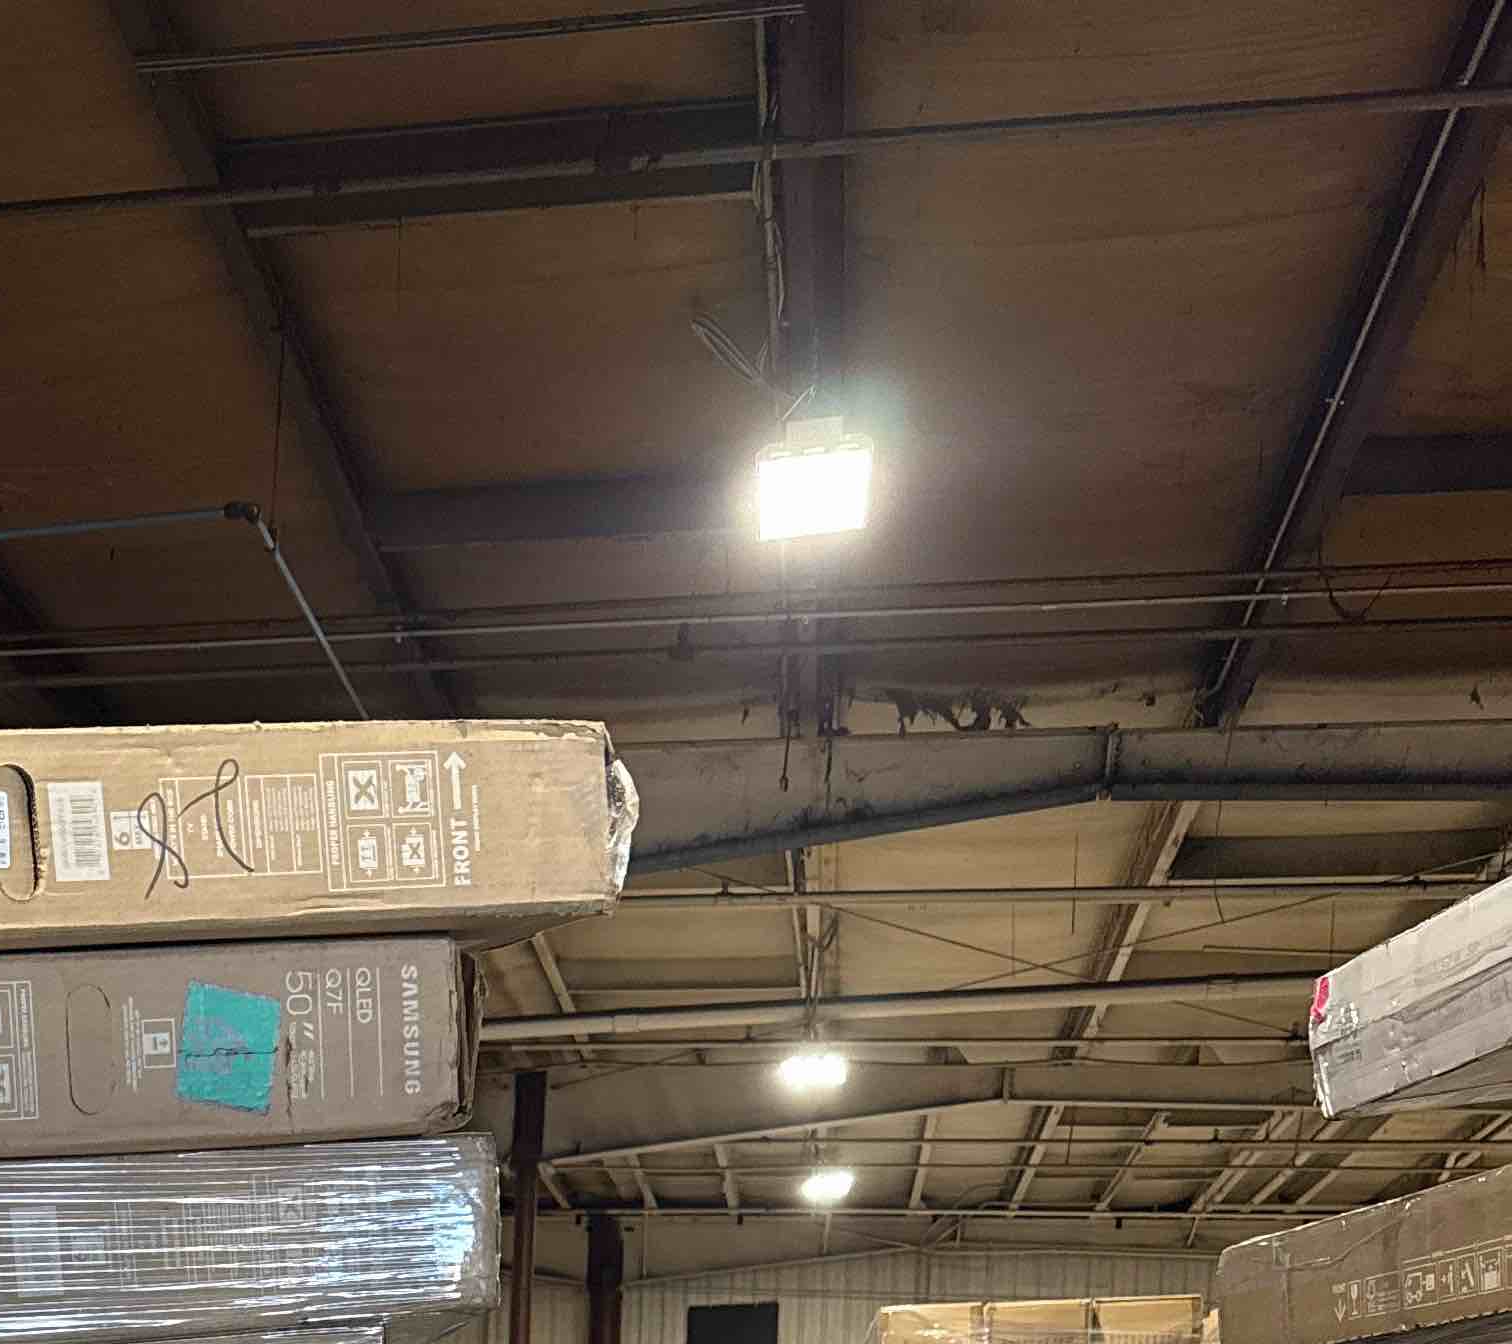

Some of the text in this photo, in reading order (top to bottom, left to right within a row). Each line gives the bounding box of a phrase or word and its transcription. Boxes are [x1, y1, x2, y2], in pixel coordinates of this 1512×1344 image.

[113, 831, 131, 847] 6
[449, 816, 472, 886] FRONT
[325, 968, 345, 1018] Q7F
[355, 967, 374, 1024] QLED
[400, 964, 423, 1096] SAMSUNG
